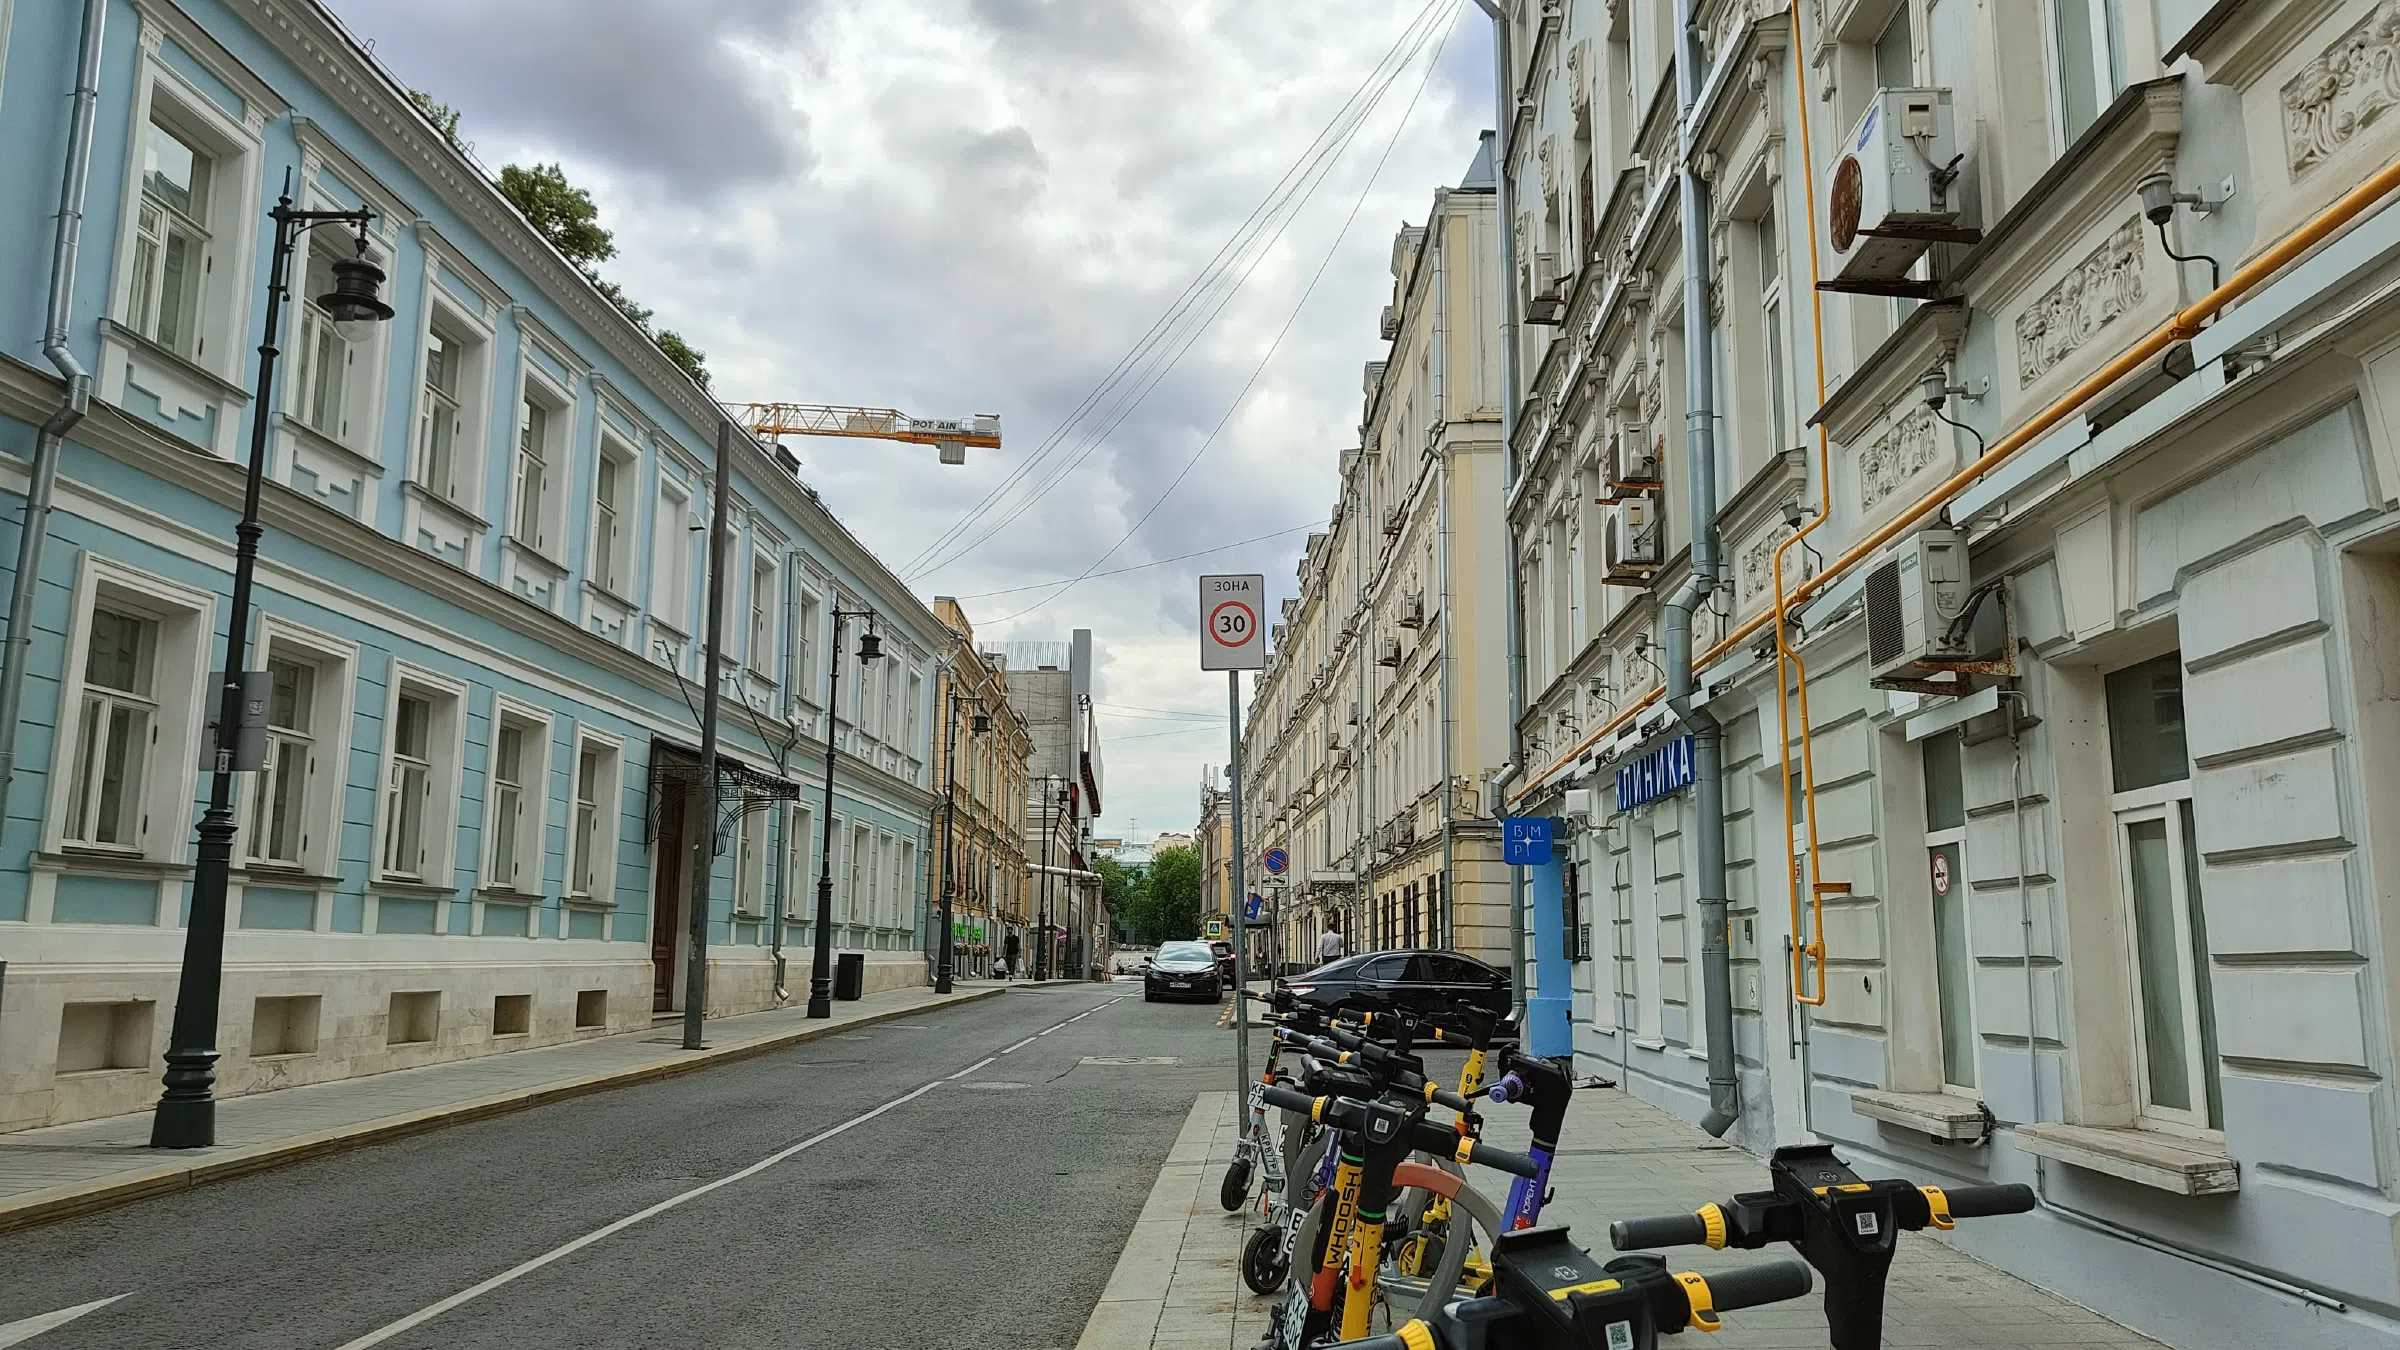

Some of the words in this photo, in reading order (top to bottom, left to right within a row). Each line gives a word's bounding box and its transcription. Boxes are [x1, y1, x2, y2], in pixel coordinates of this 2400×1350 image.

[1214, 581, 1250, 592] ЗОНА
[1220, 615, 1246, 634] 30
[1615, 735, 1692, 812] КЛИНИКА
[1522, 1178, 1538, 1214] ЮРЕНТ
[1326, 1171, 1360, 1265] WHOOSH
[1684, 1276, 1701, 1285] Go
